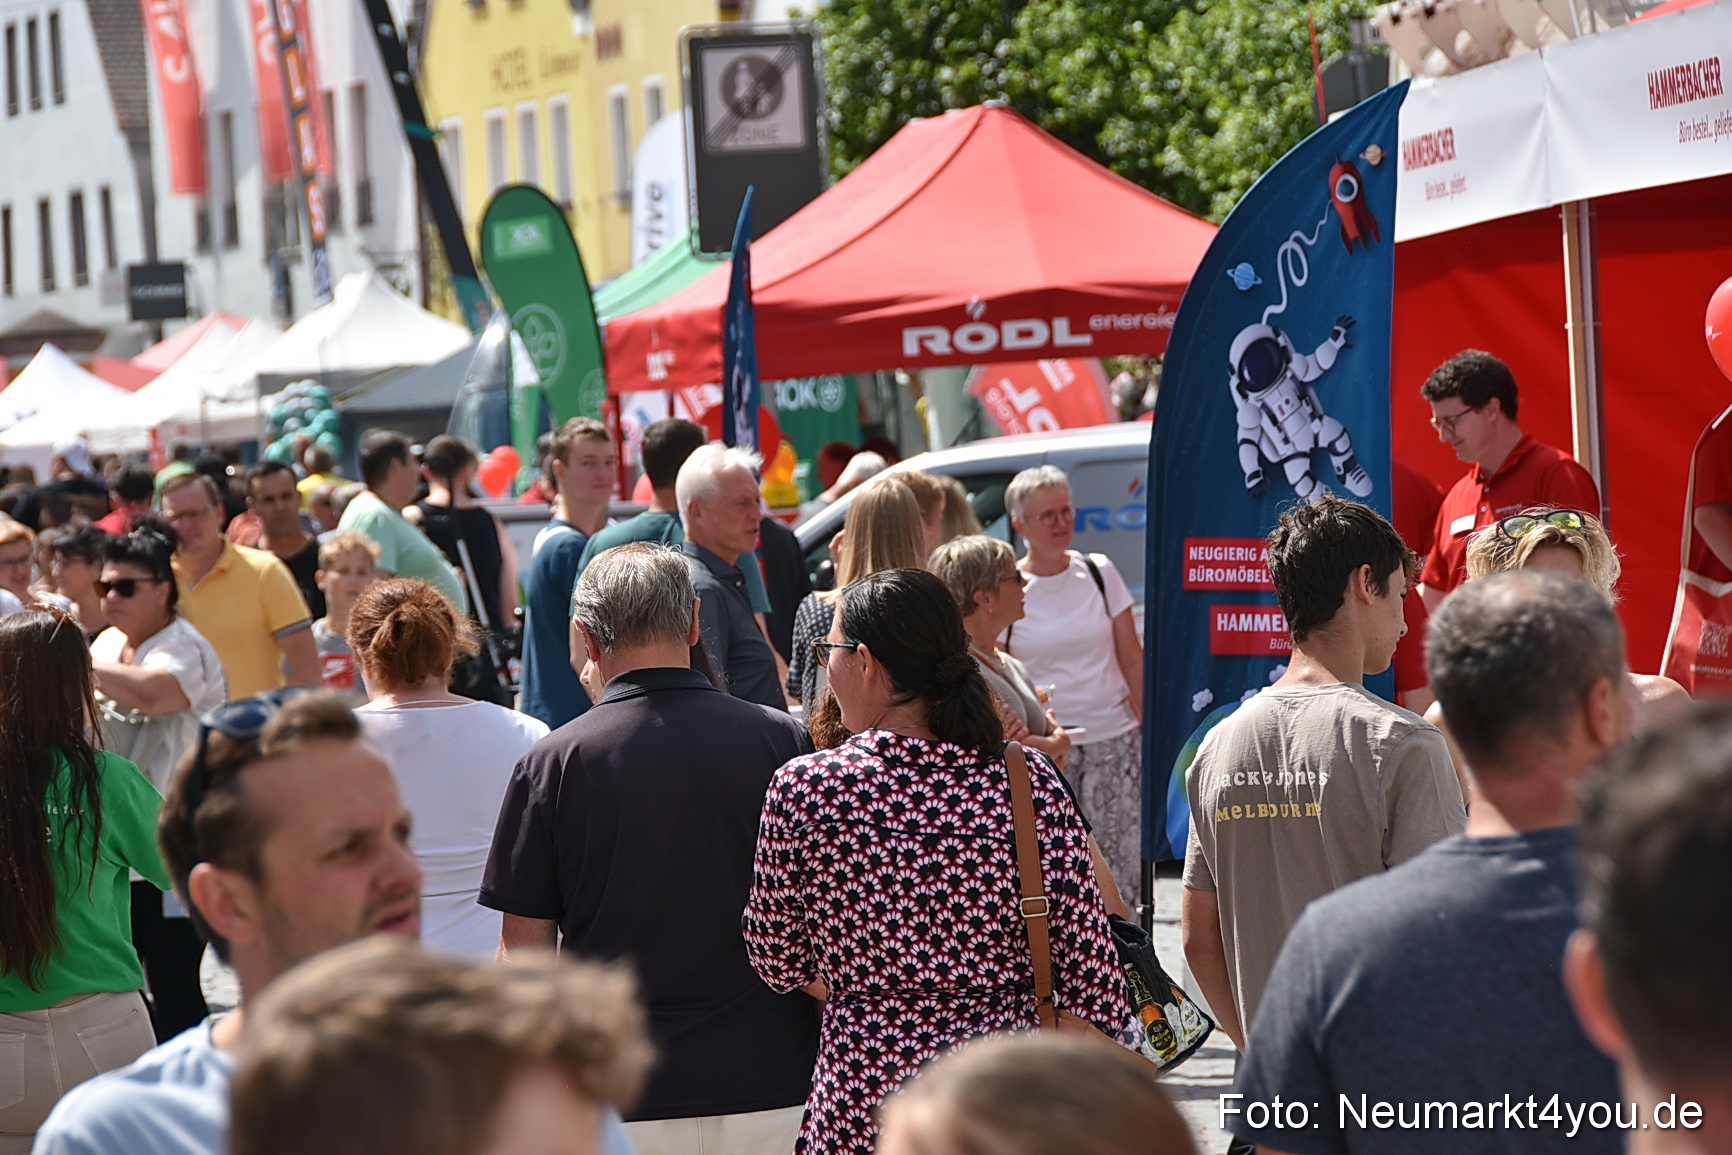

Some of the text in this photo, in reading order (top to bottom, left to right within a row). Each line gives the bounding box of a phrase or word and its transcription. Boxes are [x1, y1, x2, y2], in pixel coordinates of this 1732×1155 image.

[1648, 56, 1725, 110] HAMMERBACHER
[1402, 126, 1457, 171] HAMMERBACHER
[902, 299, 1093, 357] RÖDL
[1074, 490, 1146, 532] RÖ
[1189, 546, 1269, 562] NEUGIERIG A
